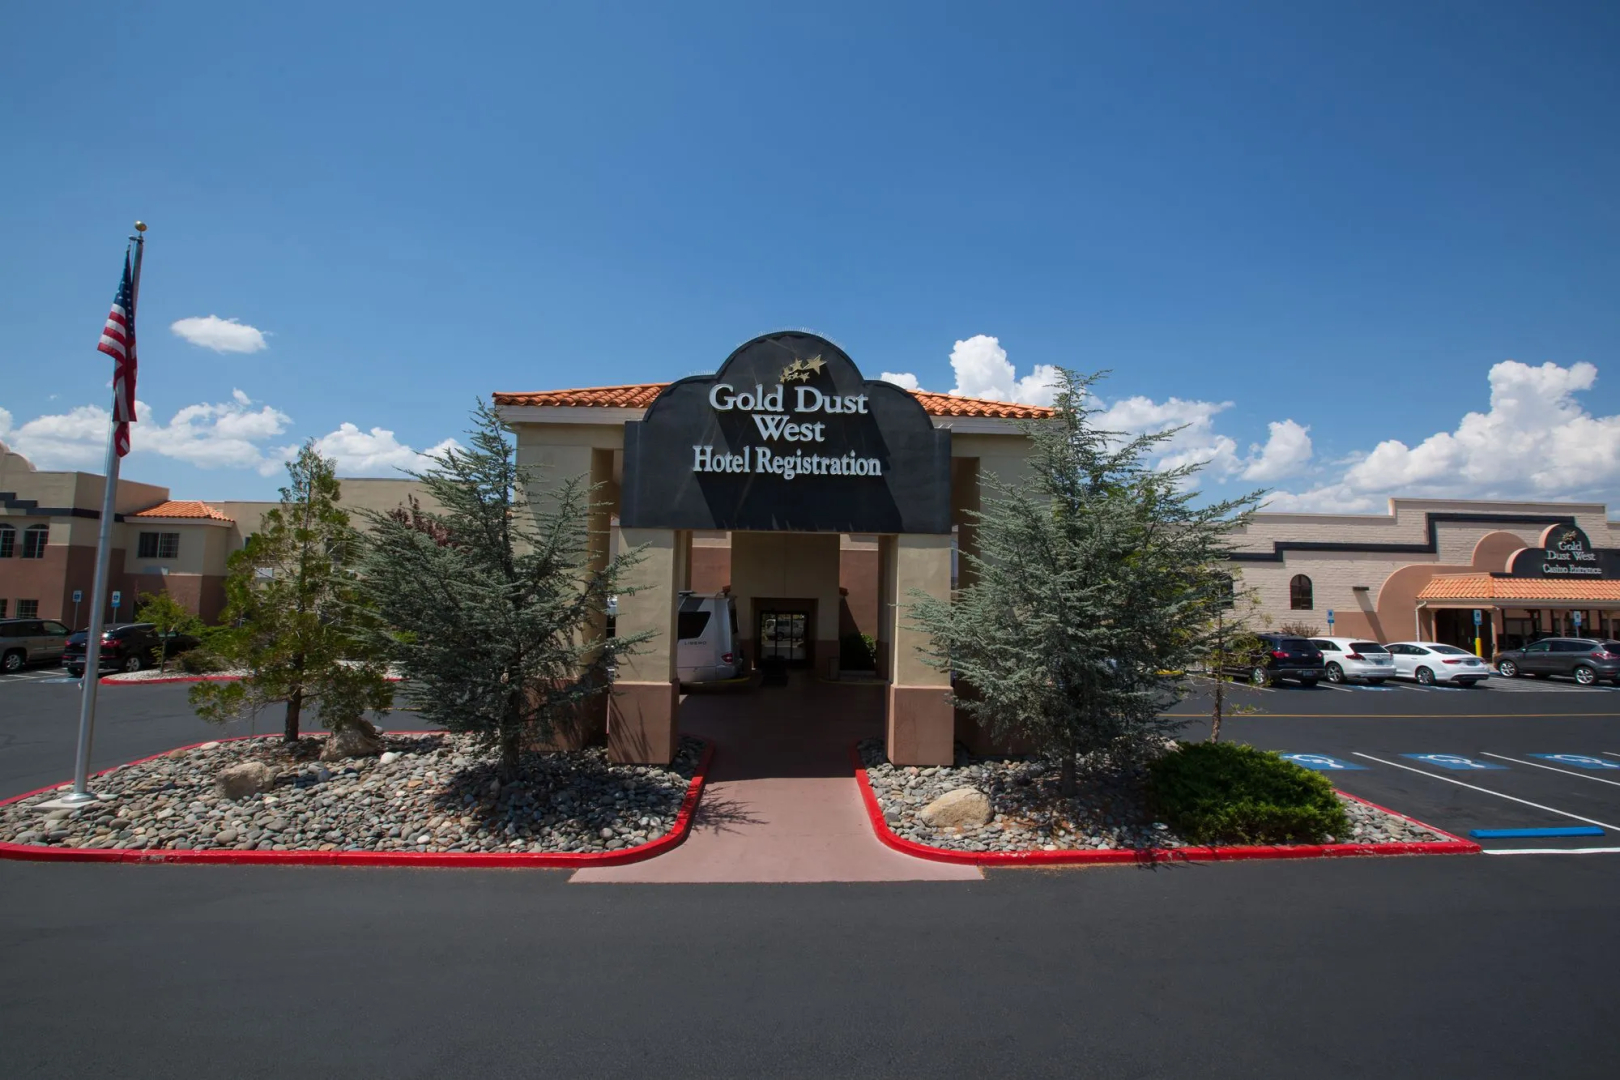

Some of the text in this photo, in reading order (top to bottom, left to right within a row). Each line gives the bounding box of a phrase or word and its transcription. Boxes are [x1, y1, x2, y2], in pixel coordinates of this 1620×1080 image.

[709, 383, 869, 414] Gold Dust
[752, 413, 826, 442] West
[692, 445, 882, 480] Hotel Registration
[1546, 550, 1596, 560] Dust West
[1558, 541, 1582, 550] Gold
[1542, 563, 1602, 574] Casino Entrance
